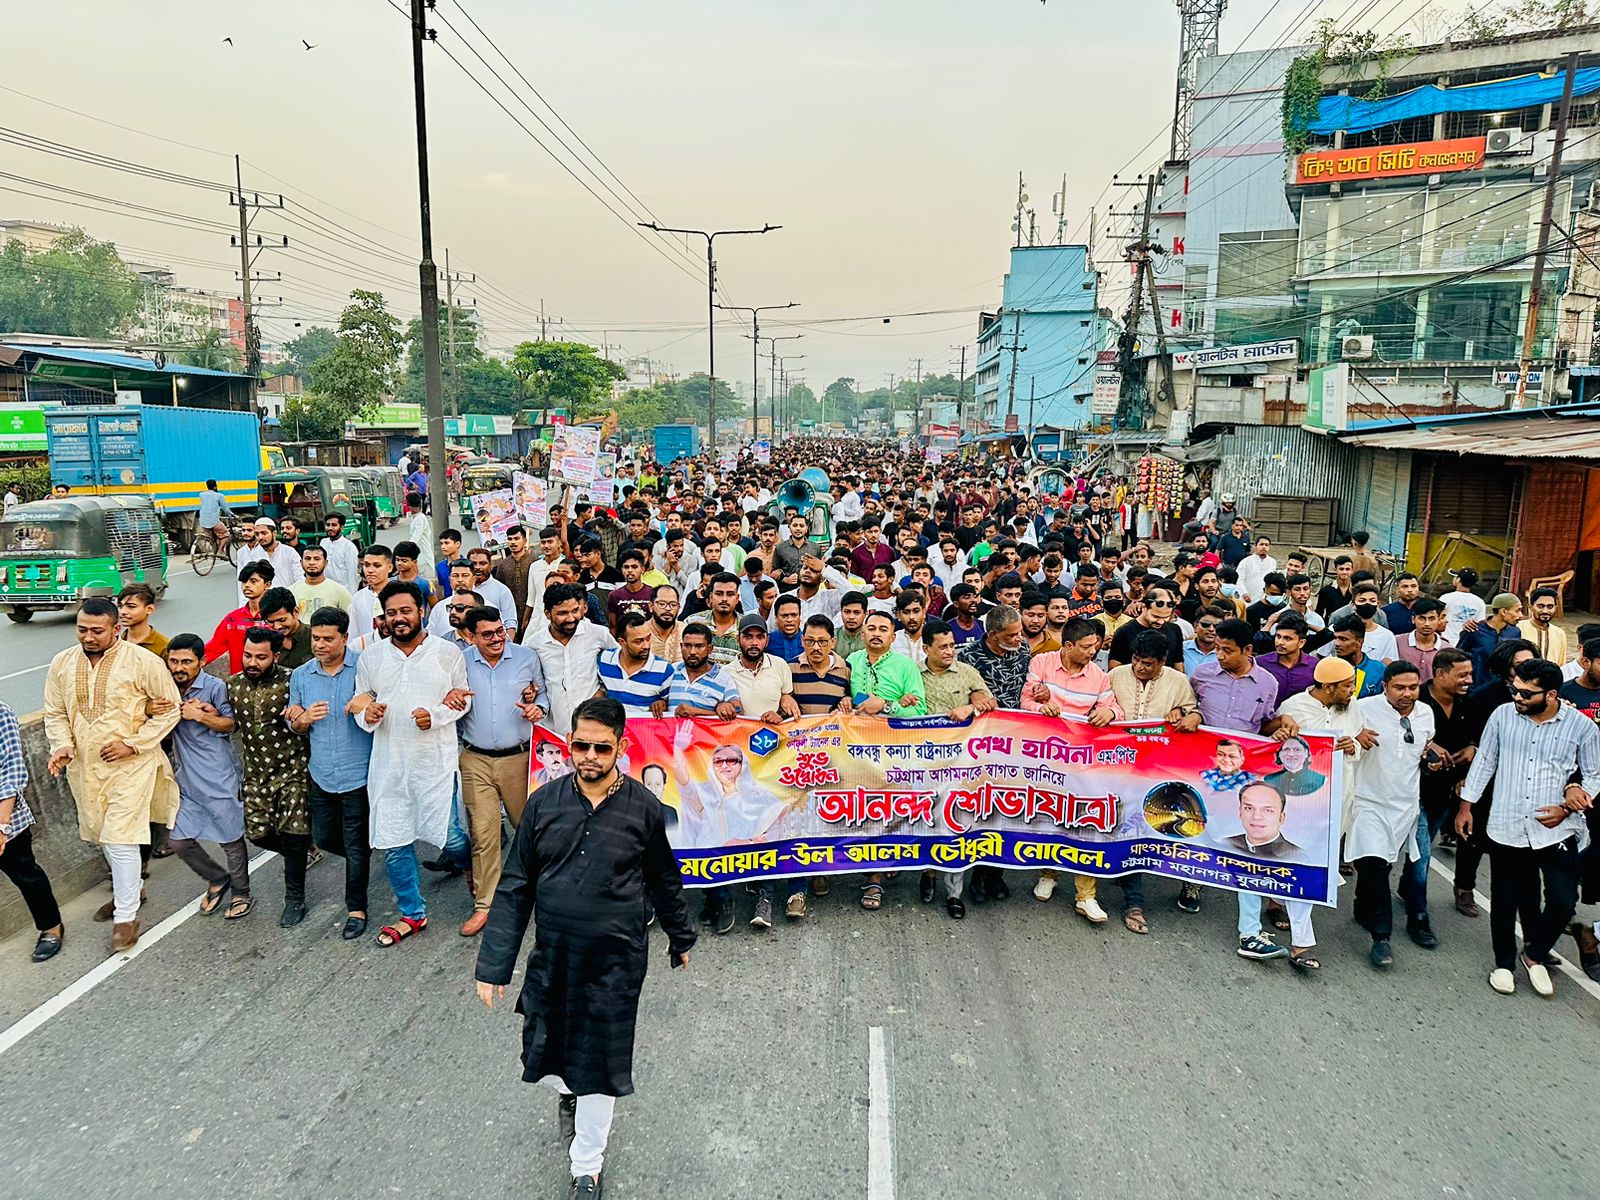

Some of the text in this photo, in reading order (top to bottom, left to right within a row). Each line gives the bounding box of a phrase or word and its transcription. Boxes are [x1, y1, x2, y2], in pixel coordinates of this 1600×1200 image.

[1303, 149, 1478, 178] কিং অব সিটি কনভেনশন
[1244, 343, 1294, 358] মার্সেল
[1082, 443, 1110, 467] WALTO
[751, 734, 778, 751] ২৮
[847, 744, 881, 763] বঙ্গবন্ধু
[884, 745, 911, 759] কন্যা
[915, 740, 962, 760] রাষ্ট্রনায়ক
[967, 736, 1013, 760] শেখ
[1021, 736, 1093, 765] হাসিনা
[796, 752, 829, 771] শুভ
[778, 766, 839, 787] উদ্বোধন
[885, 764, 1066, 787] চট্টগ্রাম আগমনকে স্বাগত জানিয়ে
[815, 782, 1120, 833] আনন্দ শোভাযাত্রা
[843, 843, 921, 863] আলম
[931, 832, 1005, 863] চৌধুরী
[1014, 841, 1111, 870] নোবেল,
[1130, 843, 1297, 881] সাংগঠনিক সম্পাদক,
[1121, 857, 1164, 868] চট্টগ্রাম
[1169, 861, 1232, 882] মহানগর
